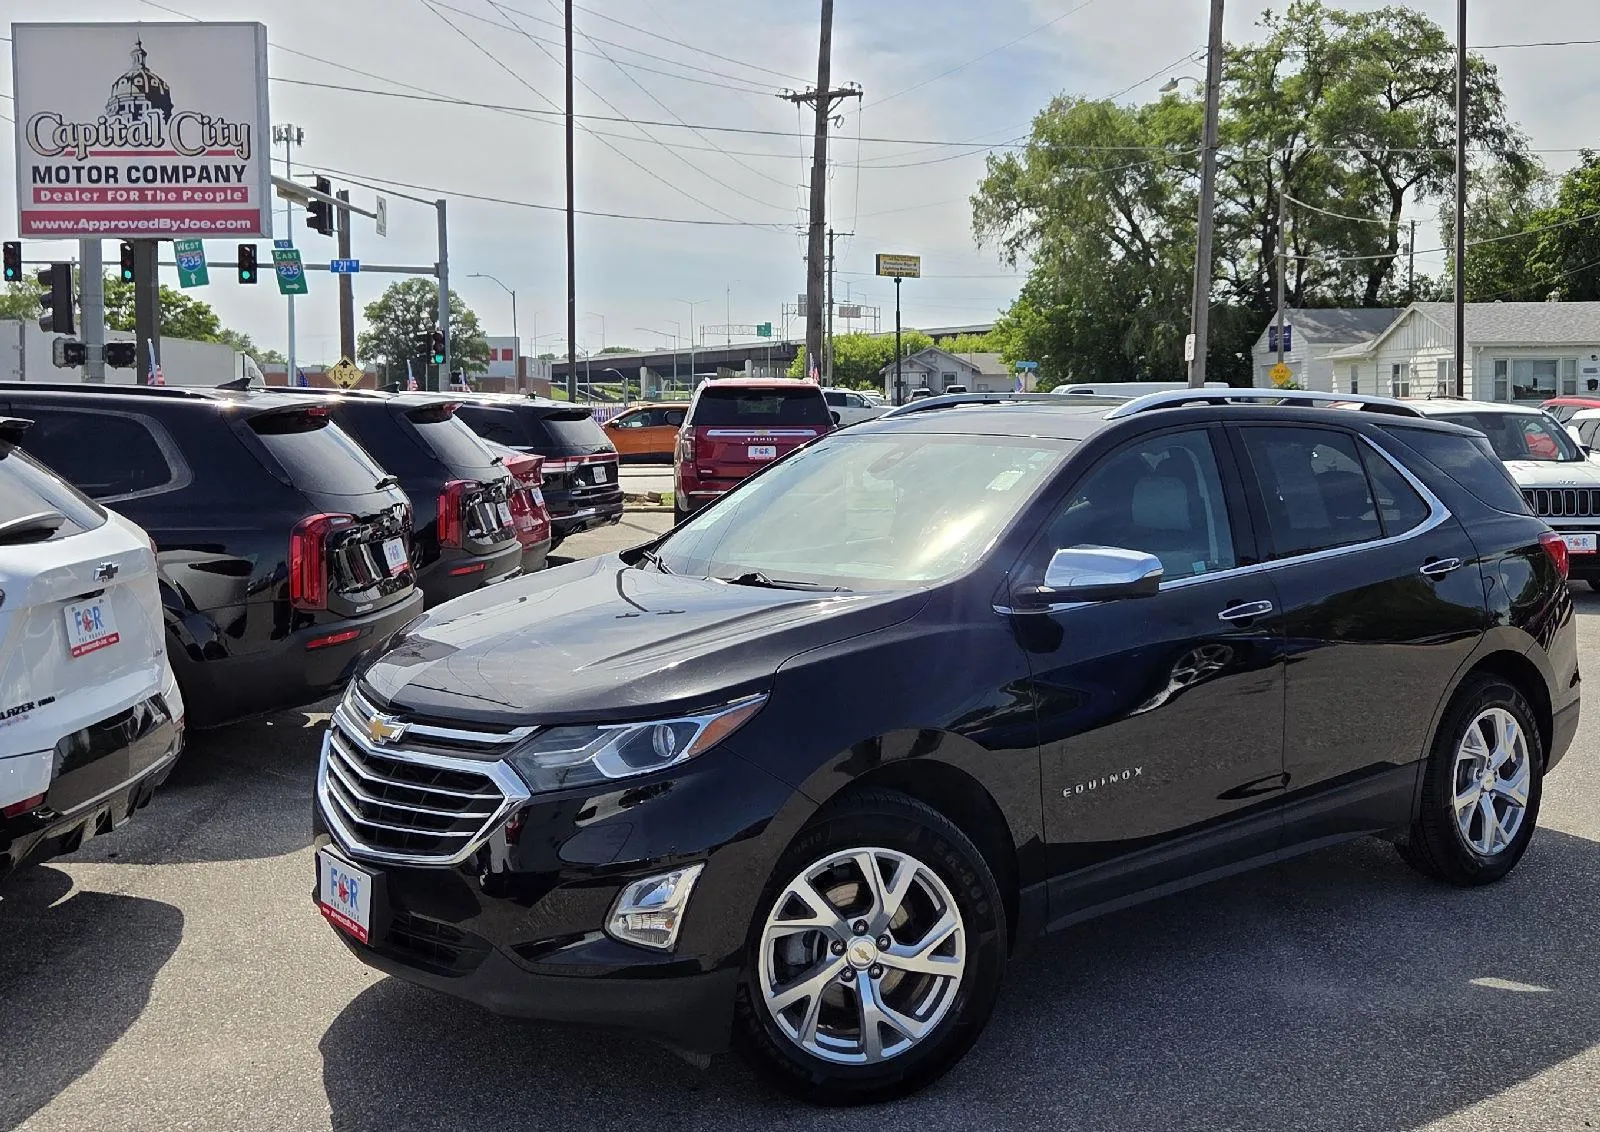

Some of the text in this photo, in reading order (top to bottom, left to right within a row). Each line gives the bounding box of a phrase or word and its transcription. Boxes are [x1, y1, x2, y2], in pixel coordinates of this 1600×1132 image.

[26, 111, 251, 161] Capital City
[32, 164, 247, 184] MOTOR COMPANY
[40, 190, 99, 201] Dealer
[107, 190, 139, 201] FOR
[145, 189, 177, 201] The
[30, 218, 251, 231] www.ApprovedByJoe.com
[180, 255, 201, 268] 235
[280, 265, 299, 275] 235
[74, 606, 104, 635] FOR
[0, 701, 35, 720] LAZER
[1062, 766, 1143, 798] EQUINOX
[330, 867, 360, 912] FOR
